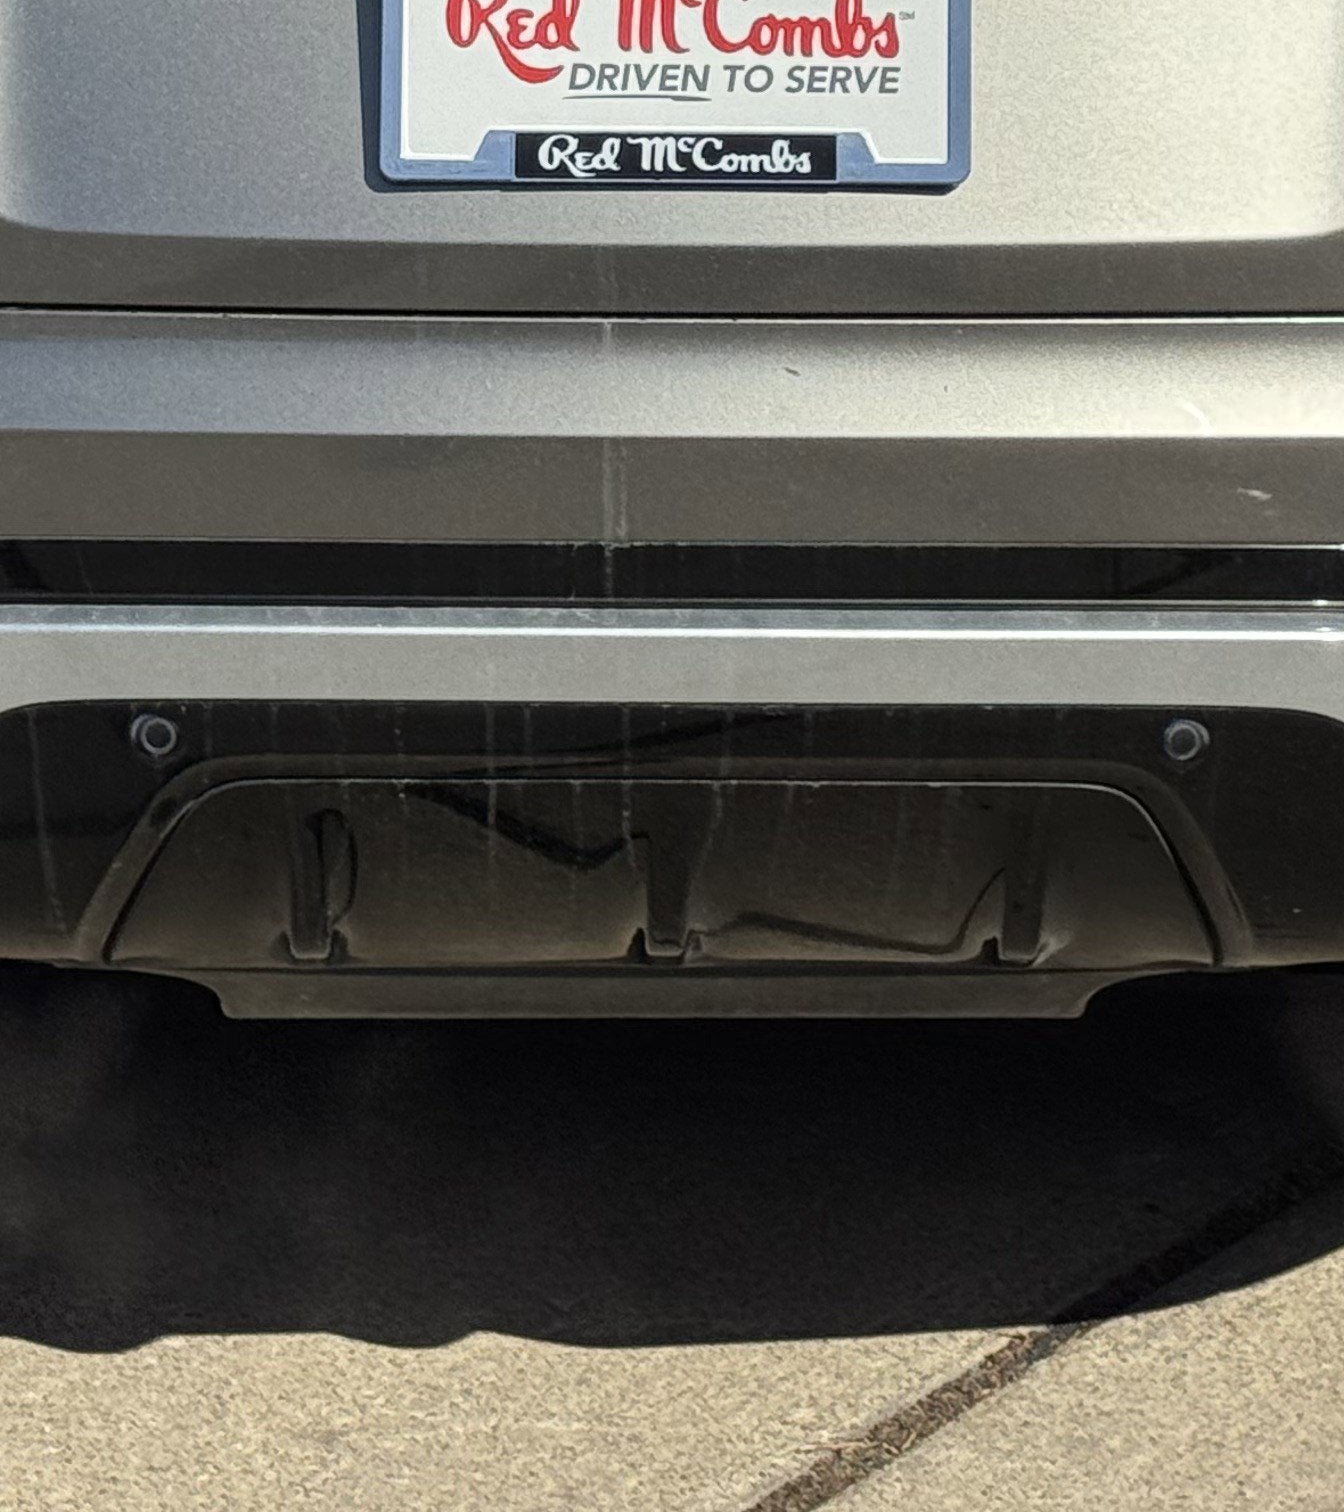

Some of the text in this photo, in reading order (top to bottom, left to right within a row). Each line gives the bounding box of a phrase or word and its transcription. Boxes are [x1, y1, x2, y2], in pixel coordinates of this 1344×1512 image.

[568, 62, 902, 95] DRIVEN TO SERVE
[537, 133, 812, 177] Red McCombs
